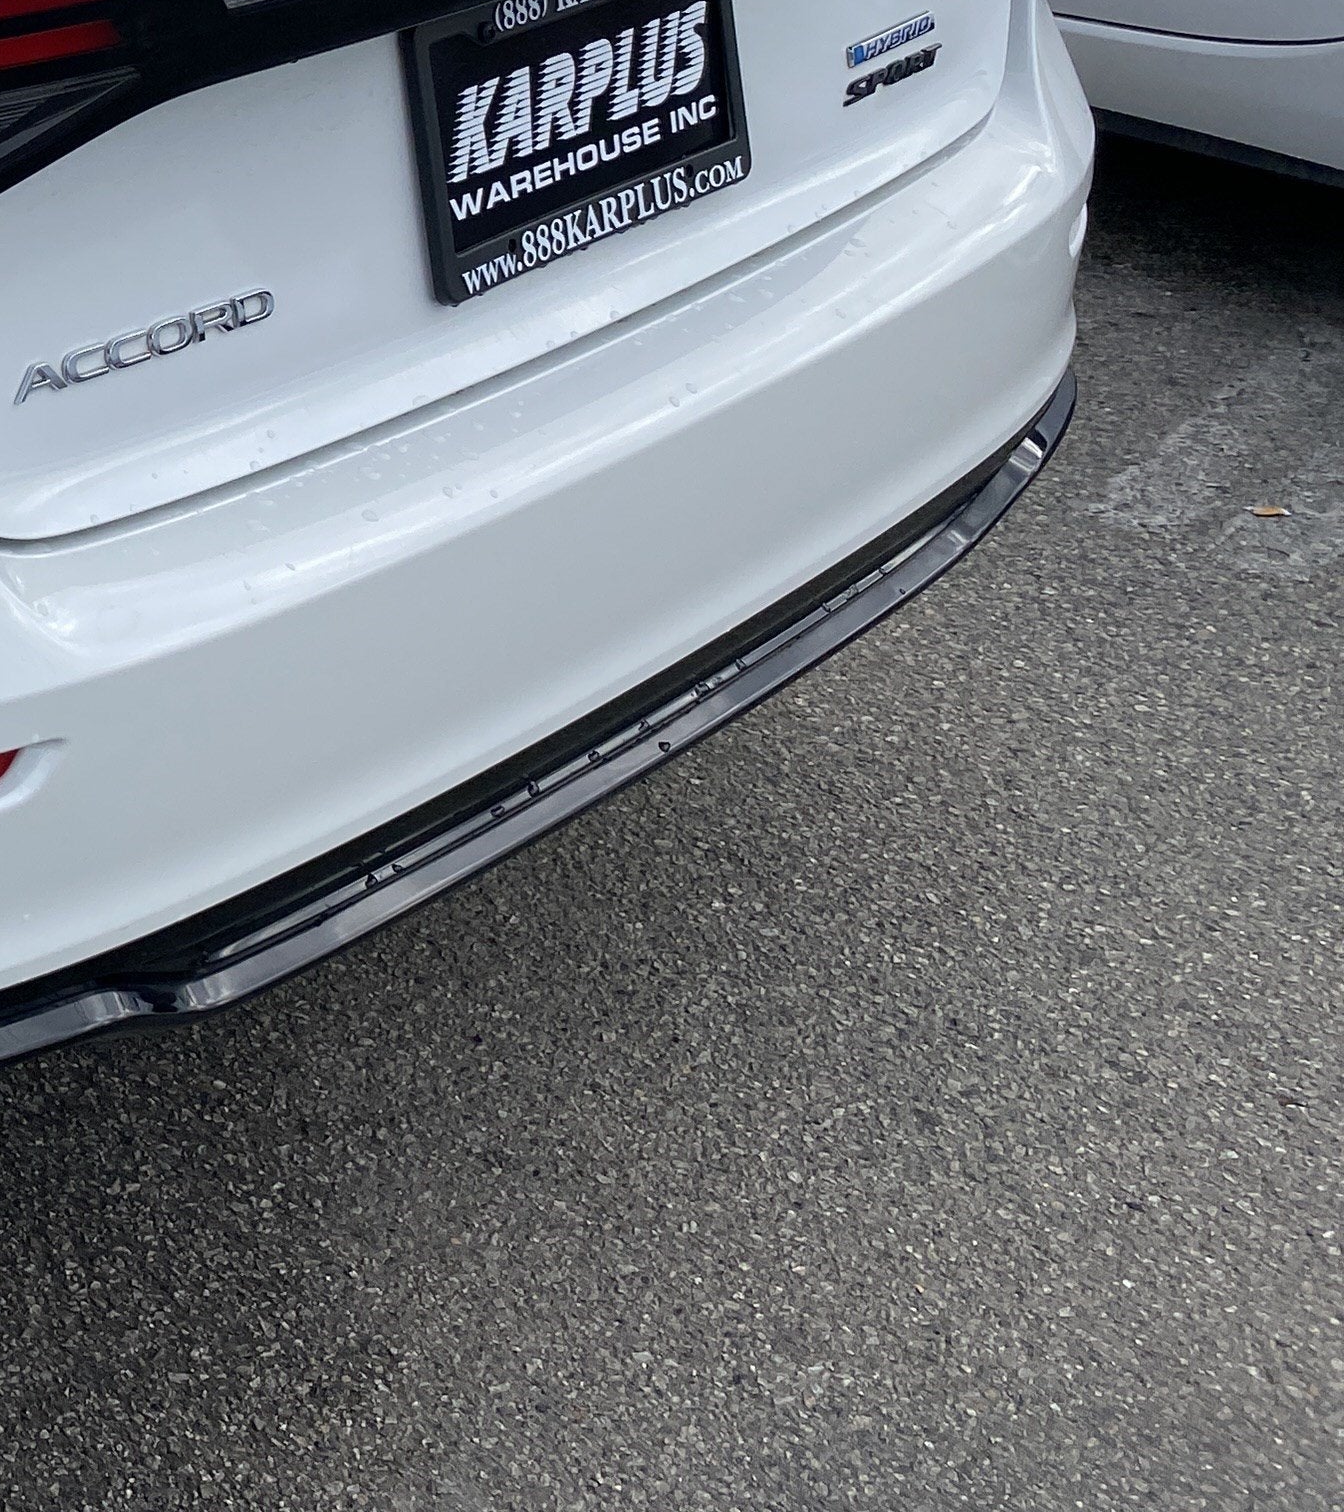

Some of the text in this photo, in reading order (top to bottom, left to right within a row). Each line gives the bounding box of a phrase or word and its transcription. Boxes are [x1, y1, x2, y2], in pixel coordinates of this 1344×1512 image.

[446, 0, 707, 184] KARPLUS
[842, 42, 943, 107] SPORT
[864, 14, 933, 60] HYBRID
[449, 94, 717, 222] WAREHOUSE INC
[13, 287, 275, 406] ACCORD
